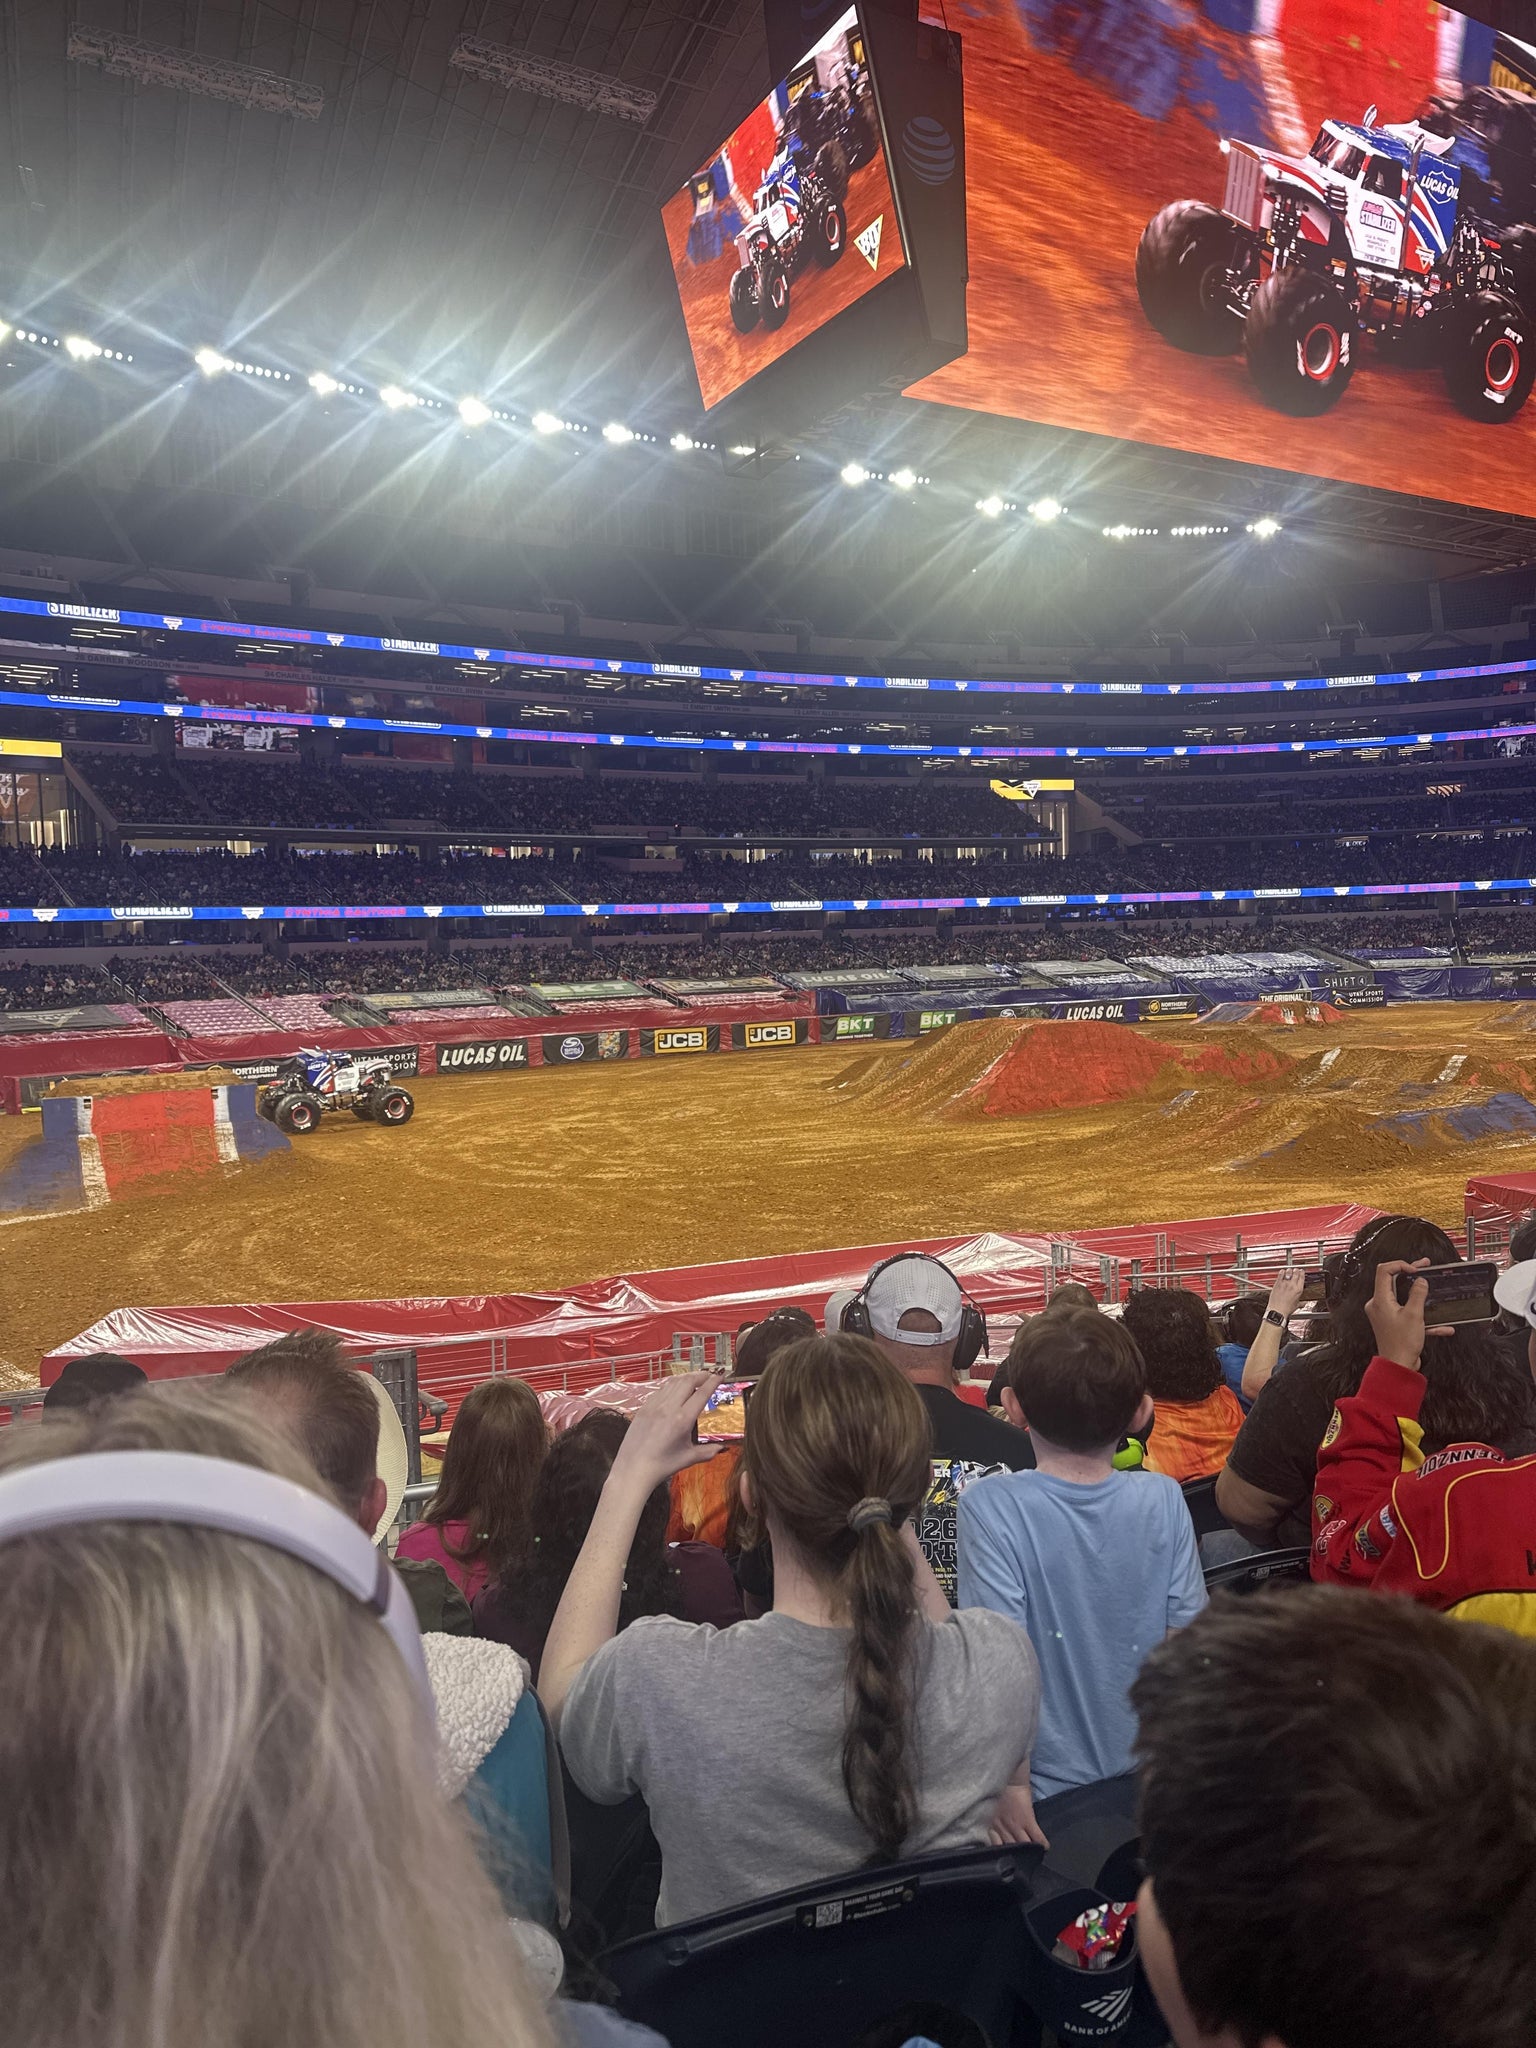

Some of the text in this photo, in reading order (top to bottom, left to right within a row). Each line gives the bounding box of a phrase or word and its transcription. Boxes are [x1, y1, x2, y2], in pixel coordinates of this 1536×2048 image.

[1420, 175, 1459, 199] LUCAS OIL
[48, 602, 119, 620] STABILIZER
[383, 637, 438, 652] STABILIZER
[653, 663, 701, 675] STABILIZER
[886, 677, 928, 687] STABILIZER
[1327, 675, 1375, 685] STABILIZER
[1101, 683, 1142, 691] STABILIZER
[801, 972, 890, 983] LUCAS OIL
[1324, 976, 1355, 988] SHIFT
[1260, 993, 1303, 1003] THE ORIGINAL
[920, 1012, 956, 1025] BKT
[1066, 1004, 1124, 1020] LUCAS OIL
[837, 1016, 875, 1032] BKT
[659, 1032, 704, 1049] JCB
[750, 1026, 792, 1043] JCB
[440, 1045, 496, 1067] LUCAS
[390, 1061, 417, 1071] SSION
[933, 1469, 951, 1478] ER
[1063, 2021, 1094, 2035] BANK
[1096, 2027, 1110, 2035] OF
